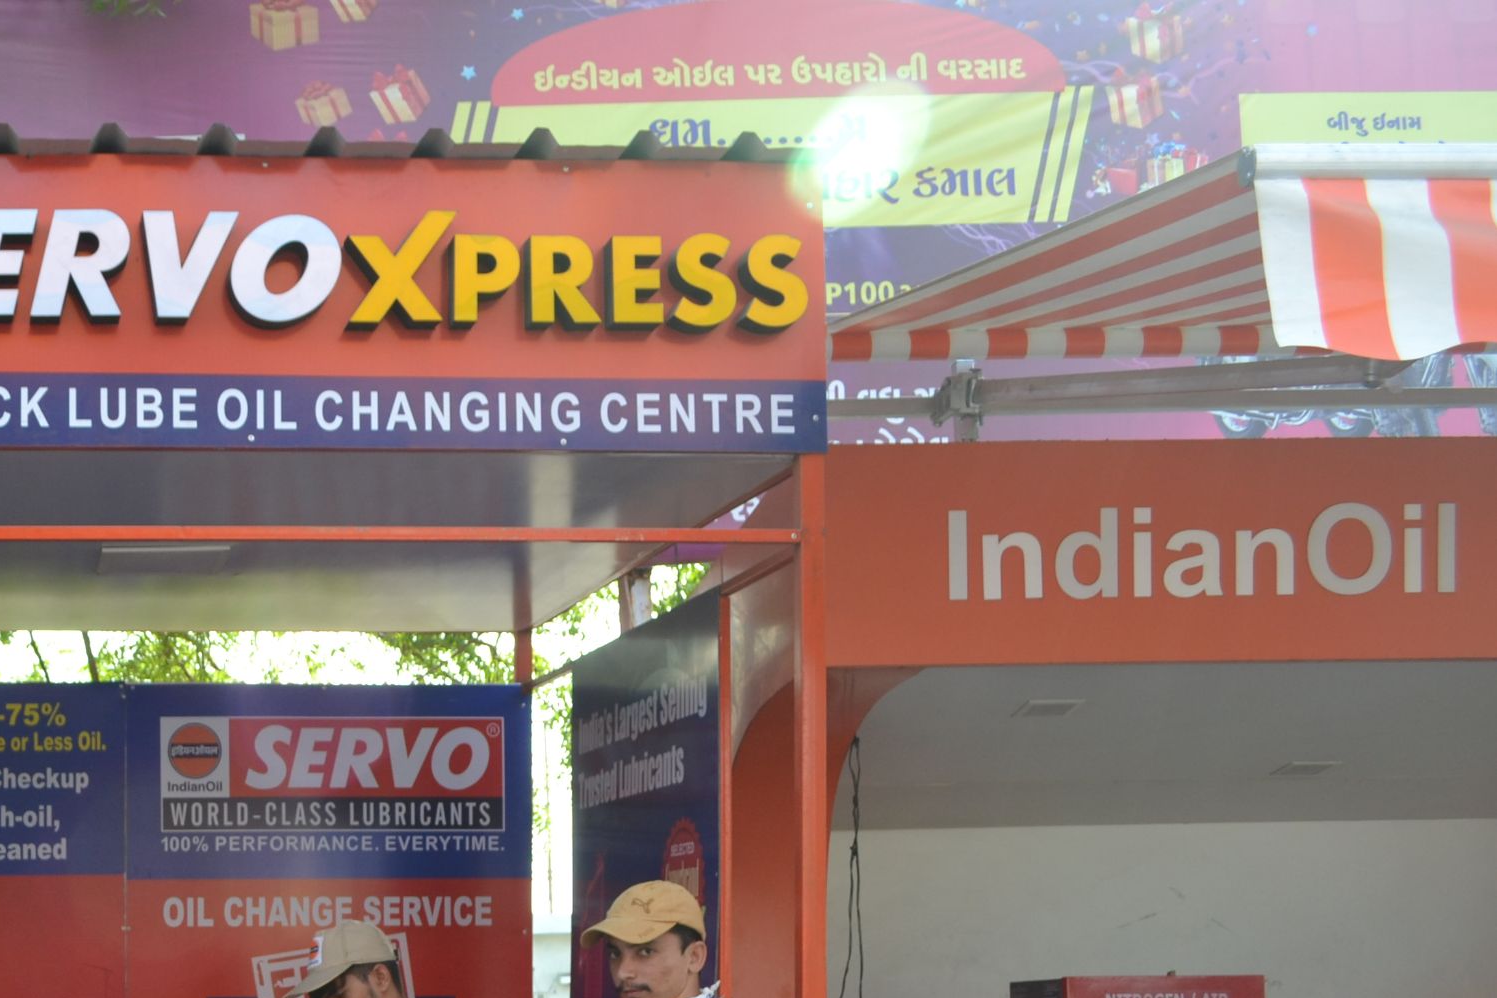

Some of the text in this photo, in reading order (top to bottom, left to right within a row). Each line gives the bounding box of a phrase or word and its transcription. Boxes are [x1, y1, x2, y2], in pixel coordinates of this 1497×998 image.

[68, 387, 198, 429] LUBE
[216, 388, 297, 431] OIL
[314, 390, 582, 433] CHANGING
[600, 392, 796, 435] CENTRE
[947, 502, 1457, 601] IndianOil
[11, 736, 29, 751] or
[33, 733, 73, 752] Less
[78, 731, 107, 752] Oil.
[245, 724, 490, 791] SERVO
[166, 779, 223, 793] IndianOil
[170, 801, 491, 827] WORLD-CLASS LUBRICANTS
[160, 835, 505, 852] 100% PERFORMANCE. EVERYTIME.
[163, 895, 493, 928] OIL CHANGE SERVICE
